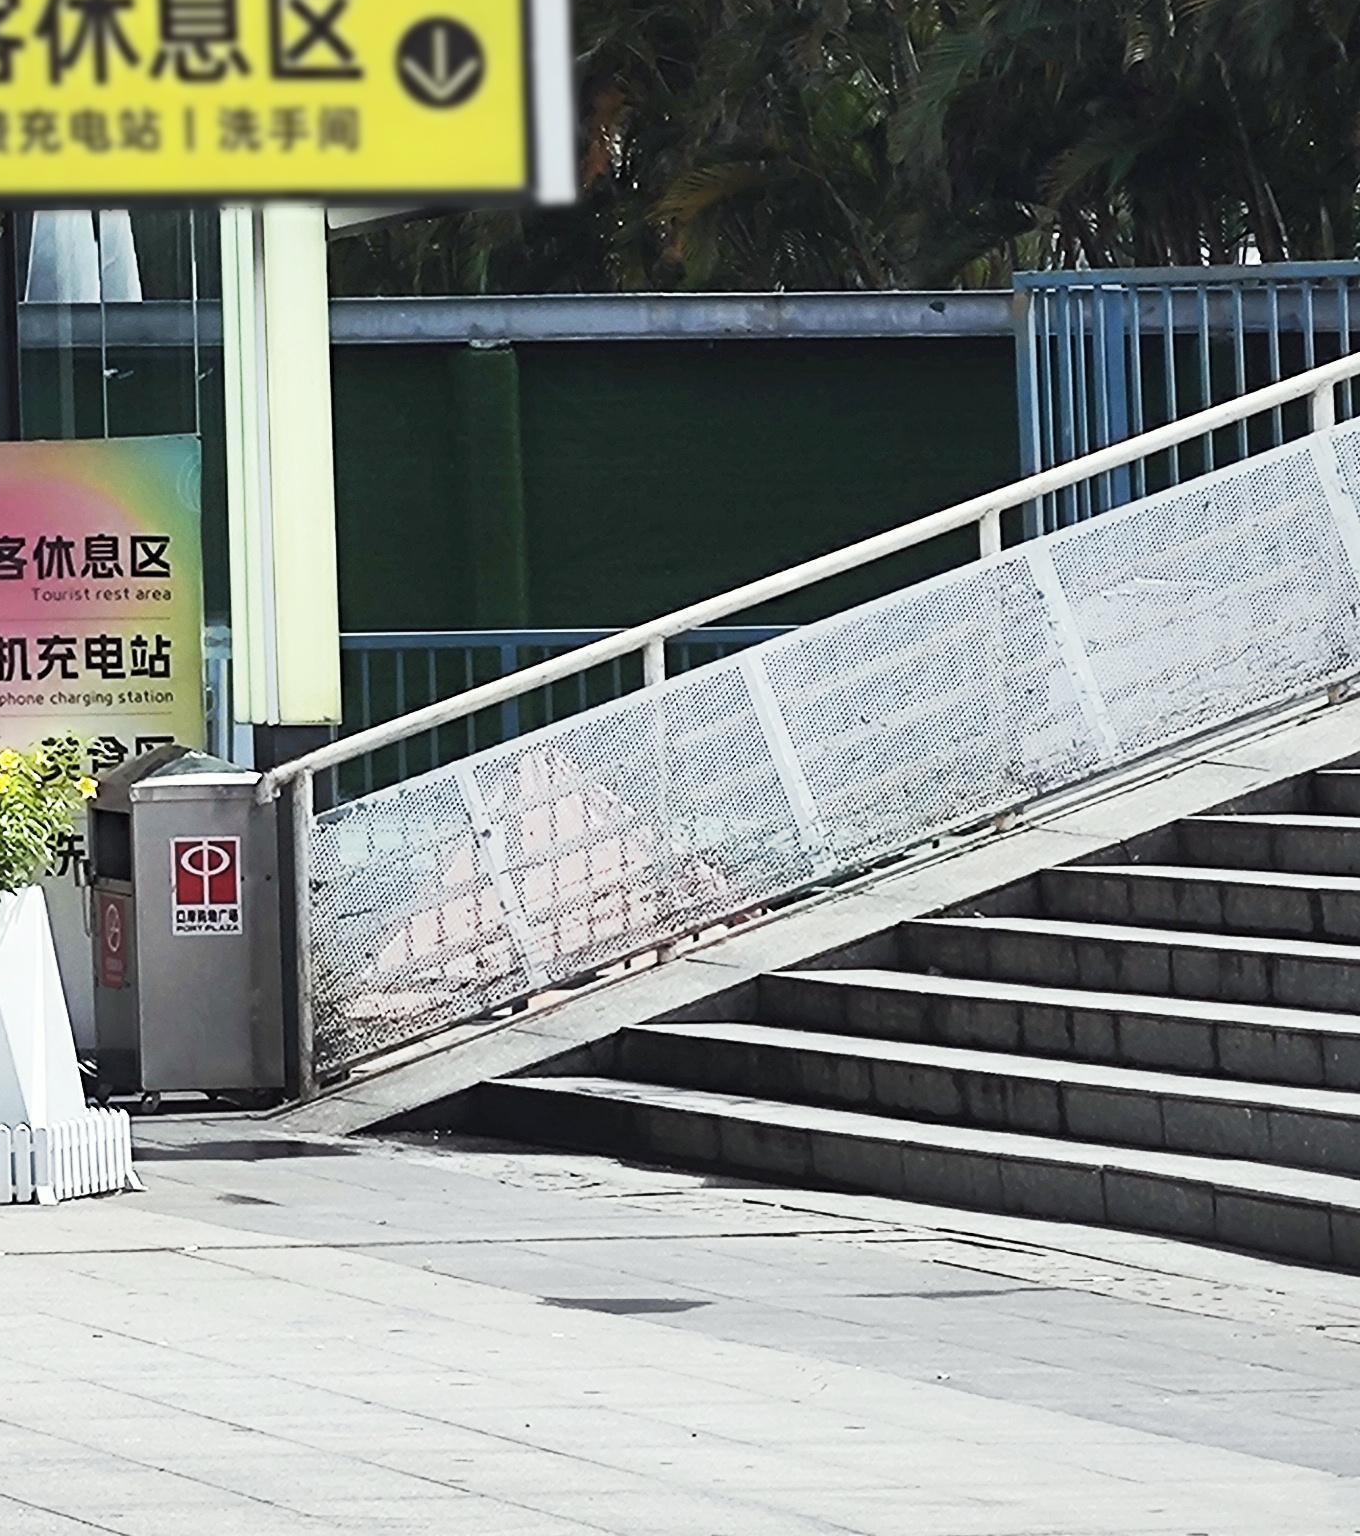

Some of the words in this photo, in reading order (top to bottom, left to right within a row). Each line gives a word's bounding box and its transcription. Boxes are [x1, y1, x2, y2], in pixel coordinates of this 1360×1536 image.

[218, 107, 362, 154] 洗手间
[32, 587, 91, 602] Tourist
[94, 587, 131, 602] rest
[134, 589, 172, 602] area
[0, 692, 44, 707] phone
[50, 691, 113, 707] charging
[119, 690, 174, 703] station
